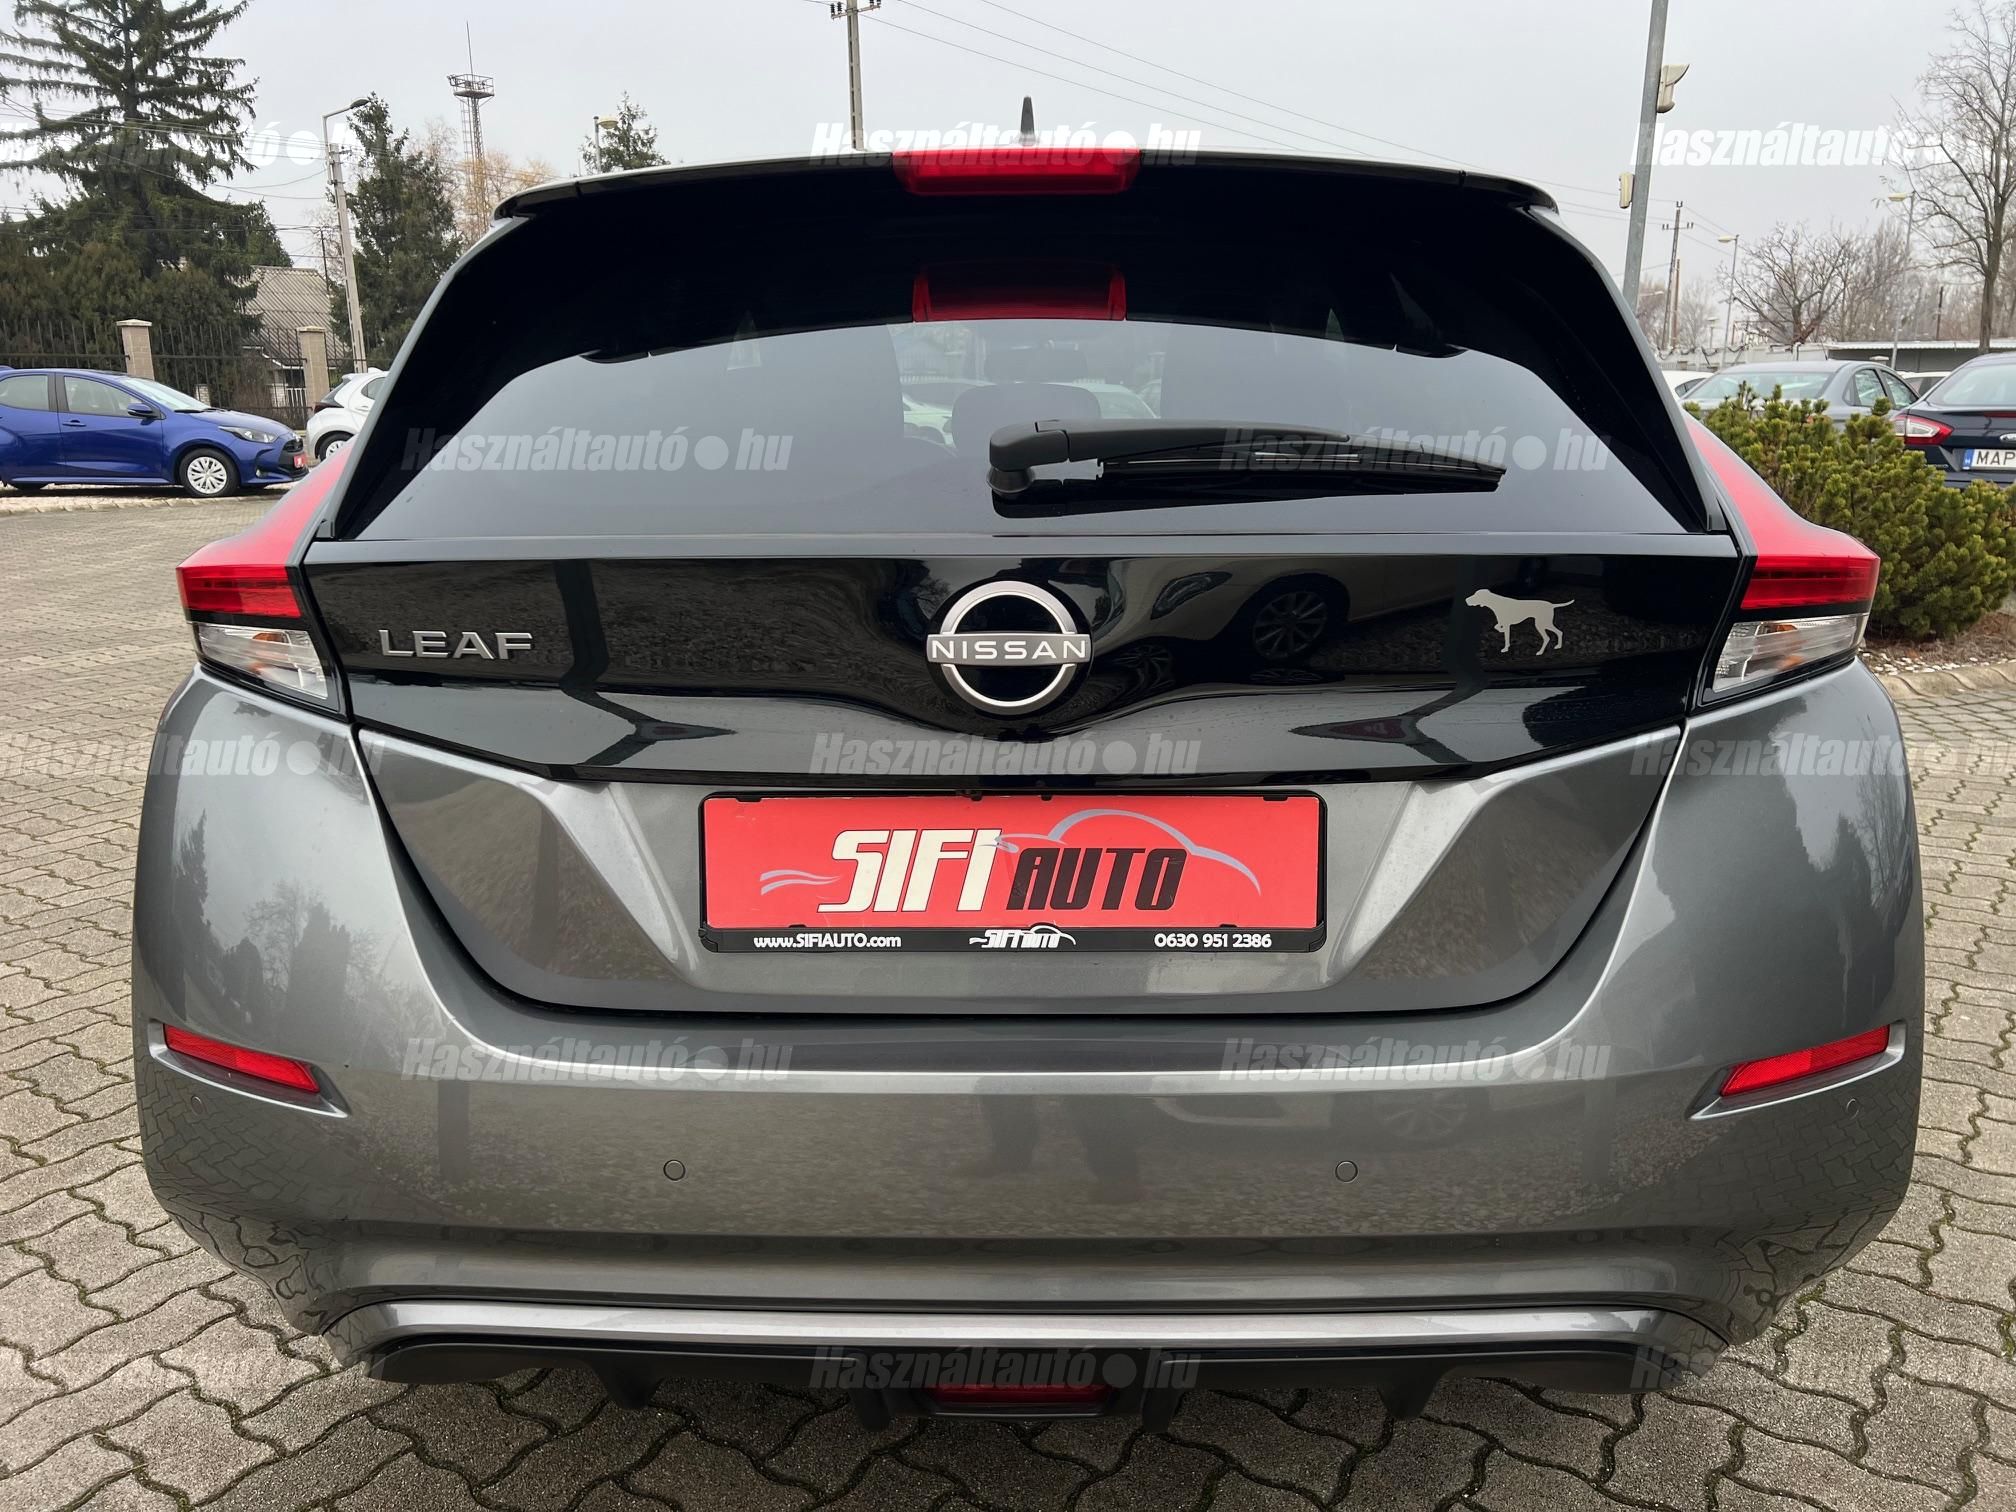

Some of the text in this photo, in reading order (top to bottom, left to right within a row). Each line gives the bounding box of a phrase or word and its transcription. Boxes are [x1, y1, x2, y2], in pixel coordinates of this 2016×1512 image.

[1976, 450, 2016, 466] MAP
[378, 629, 533, 660] LEAF
[931, 640, 1086, 660] NISSAN
[817, 829, 1188, 913] SIFI AUTO
[753, 932, 902, 948] www.SIFIAUTO.com
[1154, 932, 1272, 948] 0630 951 2386
